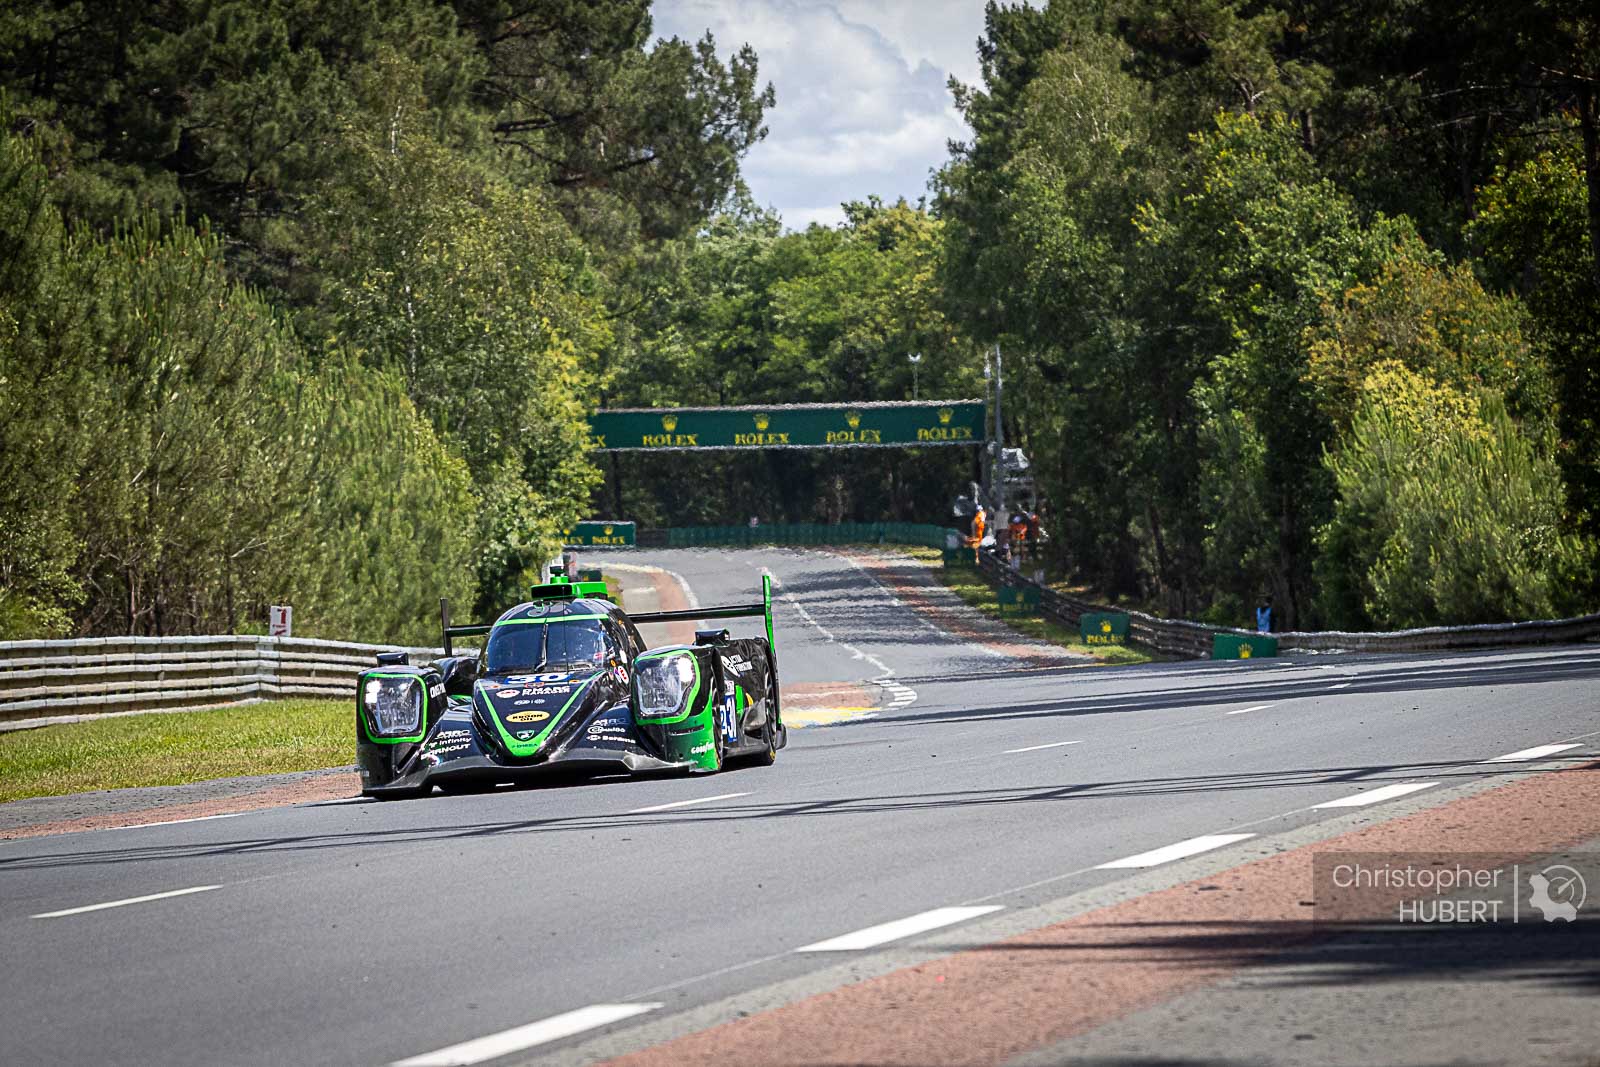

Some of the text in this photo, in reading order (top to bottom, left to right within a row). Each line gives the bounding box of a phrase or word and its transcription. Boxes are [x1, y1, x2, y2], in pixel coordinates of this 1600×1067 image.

[735, 433, 789, 445] ROLEX
[826, 430, 881, 443] ROLEX
[917, 427, 973, 440] ROLEX
[642, 434, 698, 446] ROLEX
